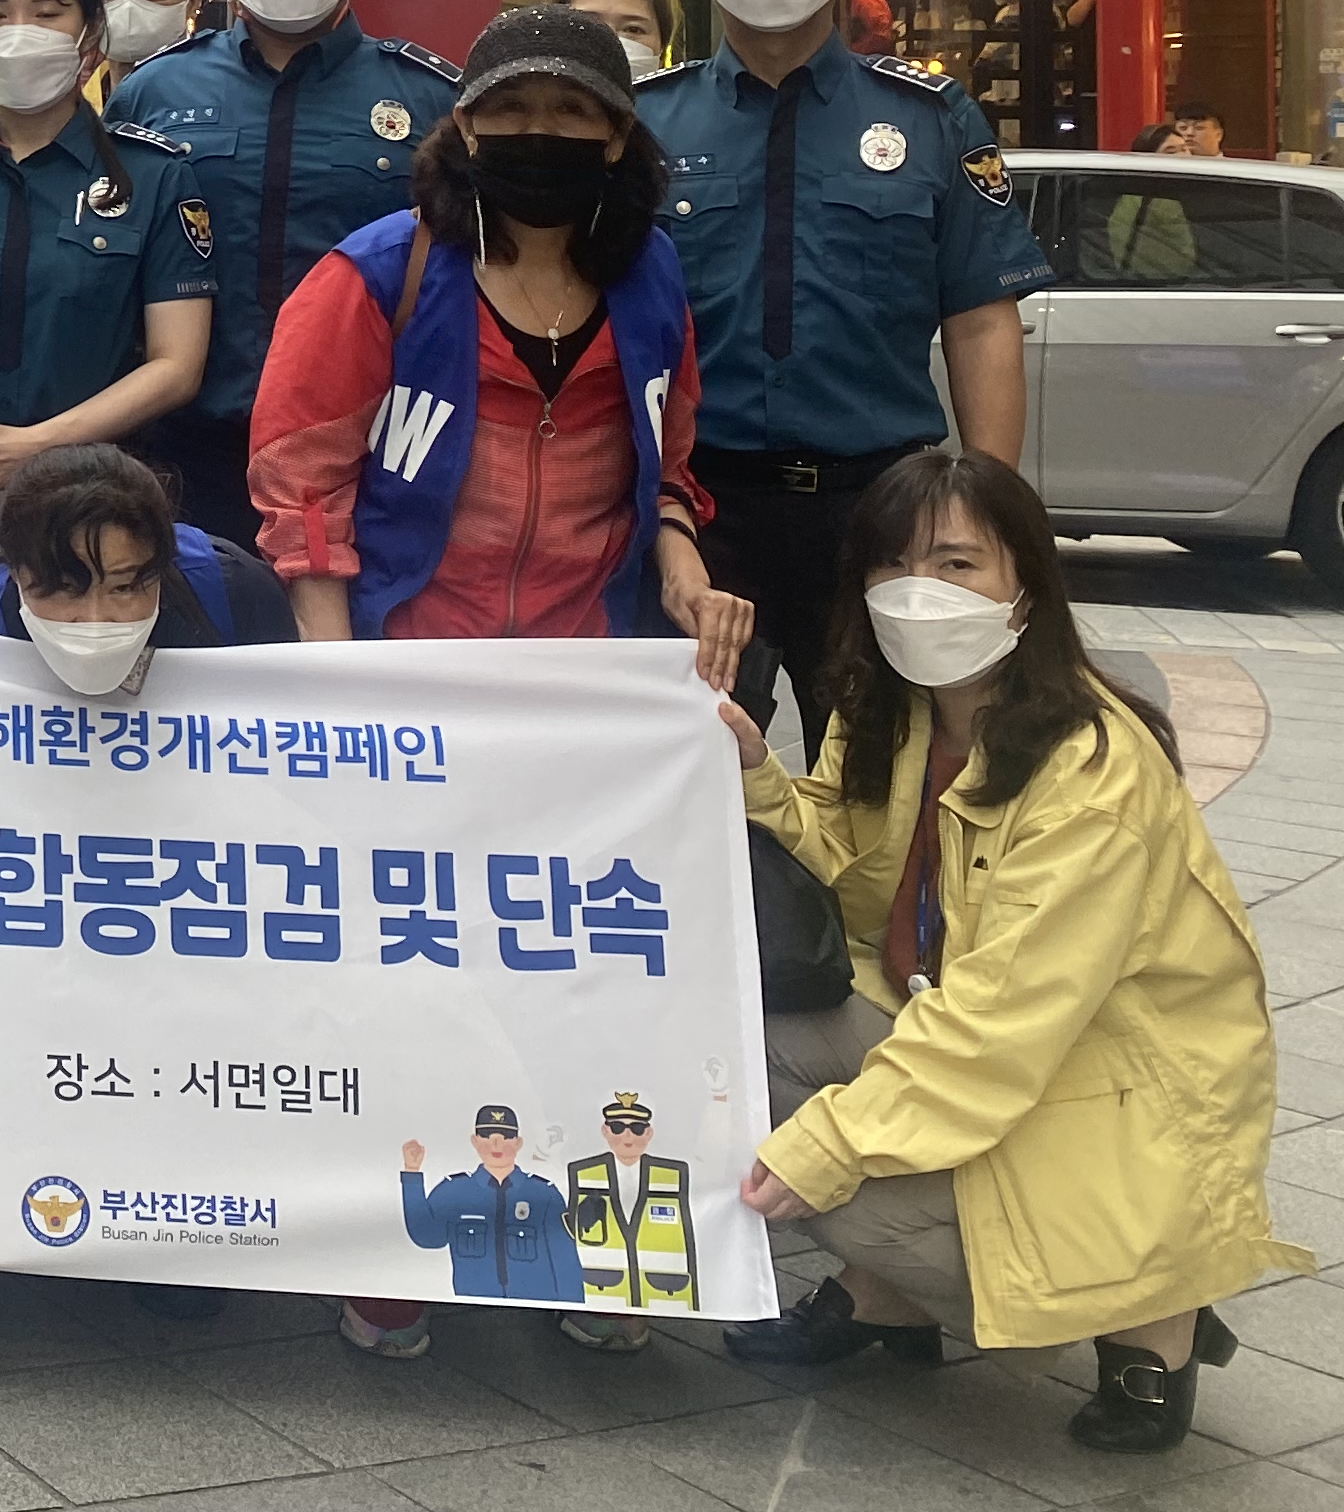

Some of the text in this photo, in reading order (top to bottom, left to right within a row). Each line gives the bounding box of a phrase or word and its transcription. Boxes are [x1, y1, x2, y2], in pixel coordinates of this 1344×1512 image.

[372, 848, 461, 969] 및
[487, 853, 670, 978] 단속
[45, 1051, 136, 1104] 장소
[178, 1063, 362, 1116] 서면일대
[99, 1189, 278, 1230] 부산진경찰서
[101, 1225, 280, 1248] Busan Jin Police Station
